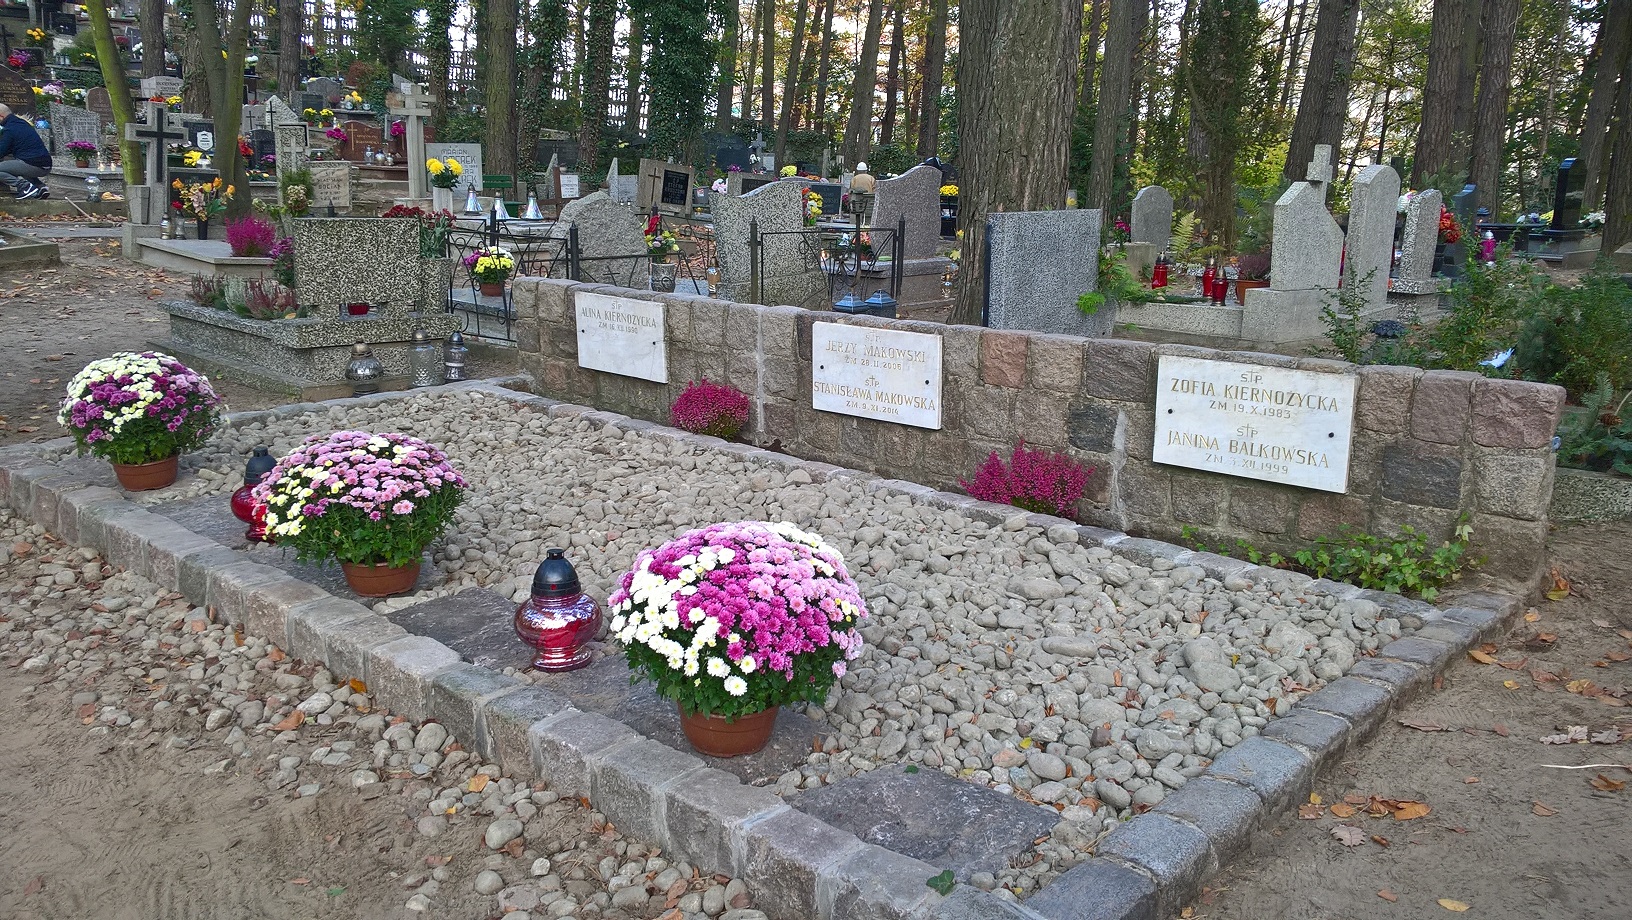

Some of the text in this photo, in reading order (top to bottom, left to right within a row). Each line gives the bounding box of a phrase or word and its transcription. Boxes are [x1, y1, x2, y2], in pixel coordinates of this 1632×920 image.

[581, 307, 601, 320] ALINA
[826, 340, 925, 363] JERZY MAKOWSKI
[814, 381, 935, 411] STANISŁAWA MAKOWSKA
[1170, 378, 1216, 397] ZOFIA
[1167, 430, 1220, 451] JANINA
